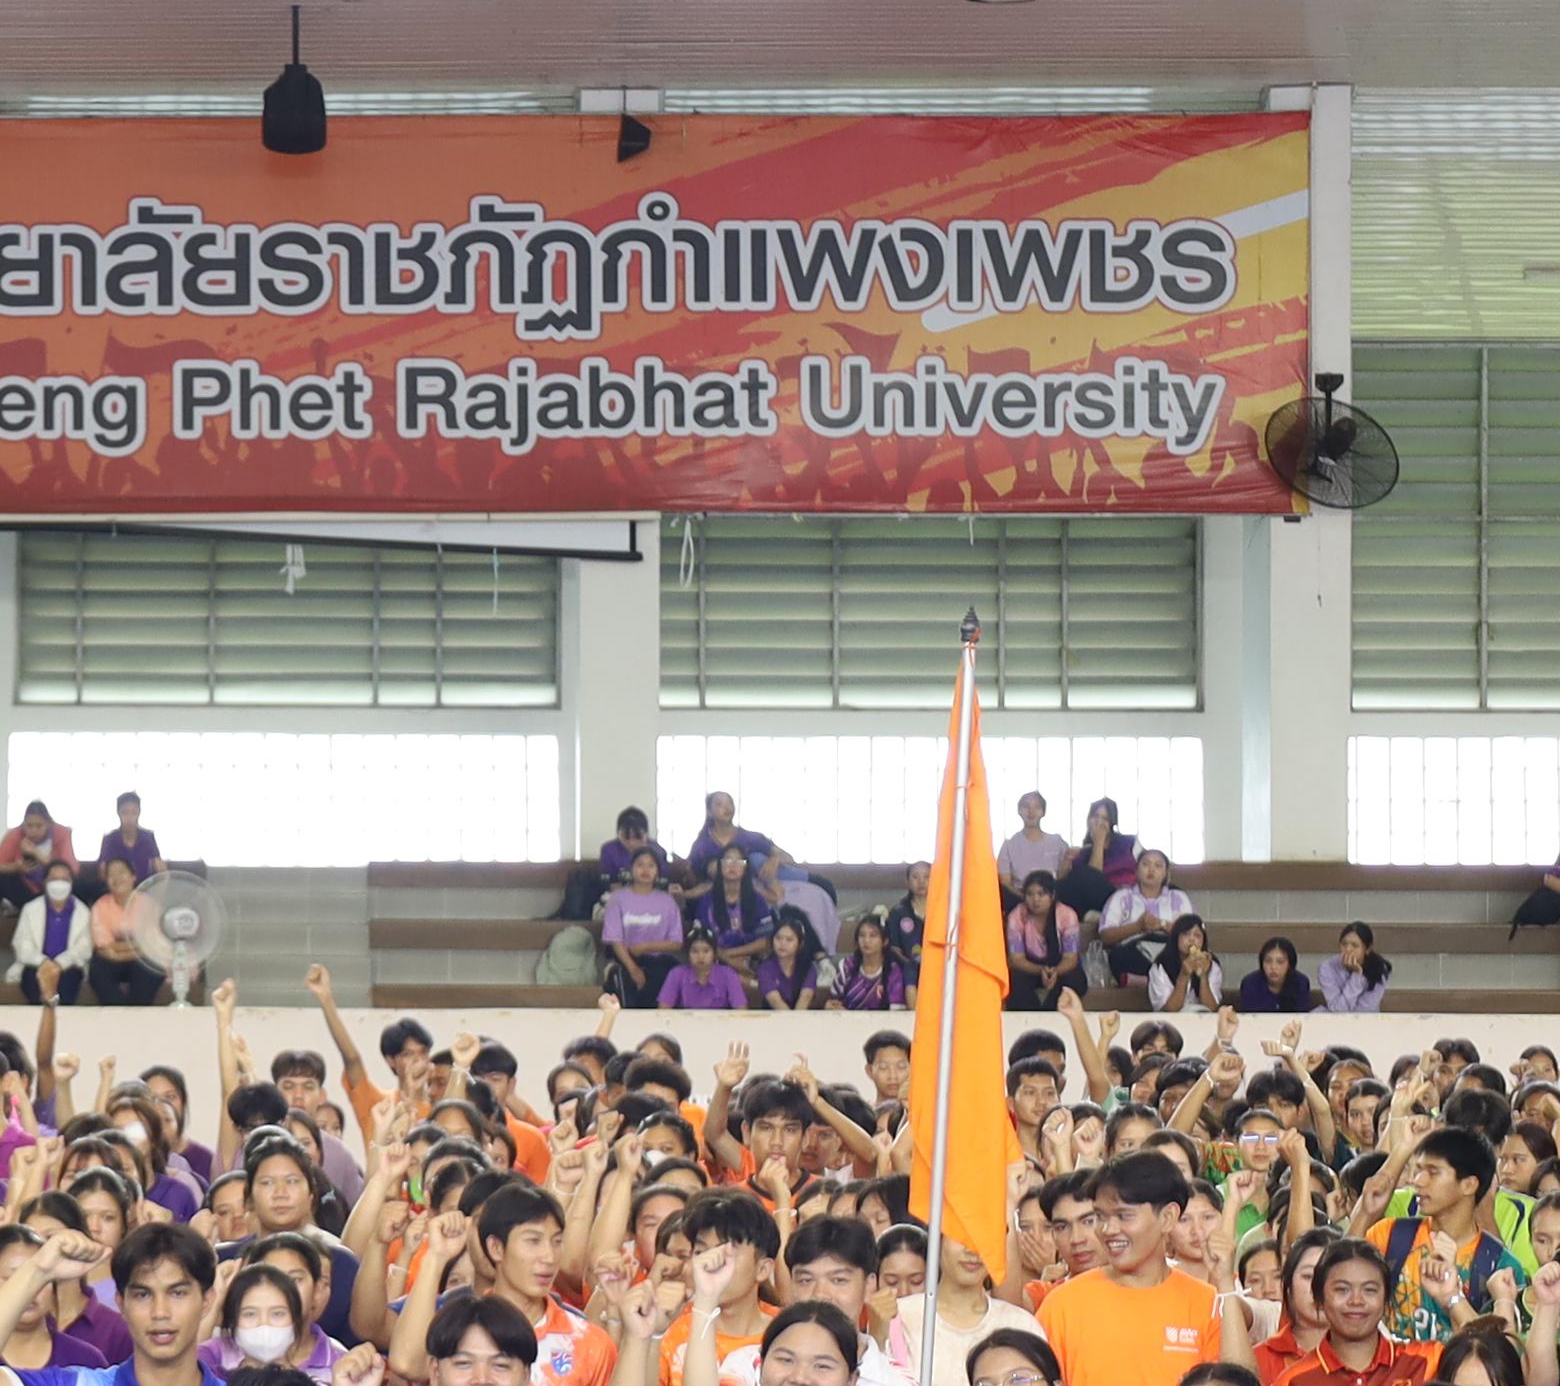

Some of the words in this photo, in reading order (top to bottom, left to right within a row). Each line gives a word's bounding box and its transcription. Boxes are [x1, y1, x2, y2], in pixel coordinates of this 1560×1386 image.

[181, 367, 365, 433] Phet
[404, 364, 769, 448] Rajabhat
[808, 364, 1219, 448] University
